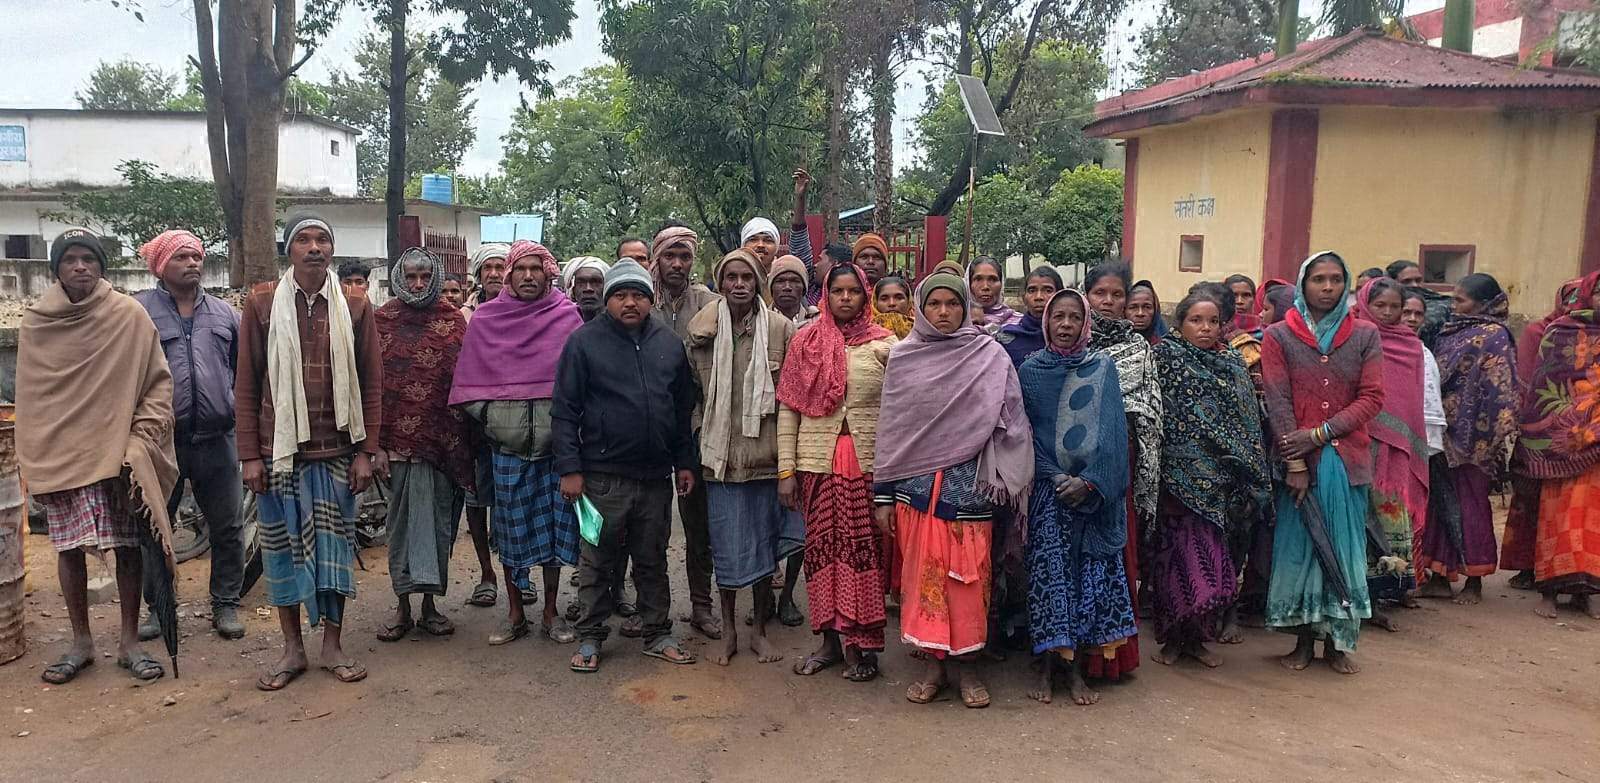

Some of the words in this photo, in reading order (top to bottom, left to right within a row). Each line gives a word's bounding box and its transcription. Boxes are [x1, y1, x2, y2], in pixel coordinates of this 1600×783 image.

[1174, 193, 1195, 218] संतरी
[1198, 198, 1215, 216] कक्ष
[64, 230, 84, 239] ICON
